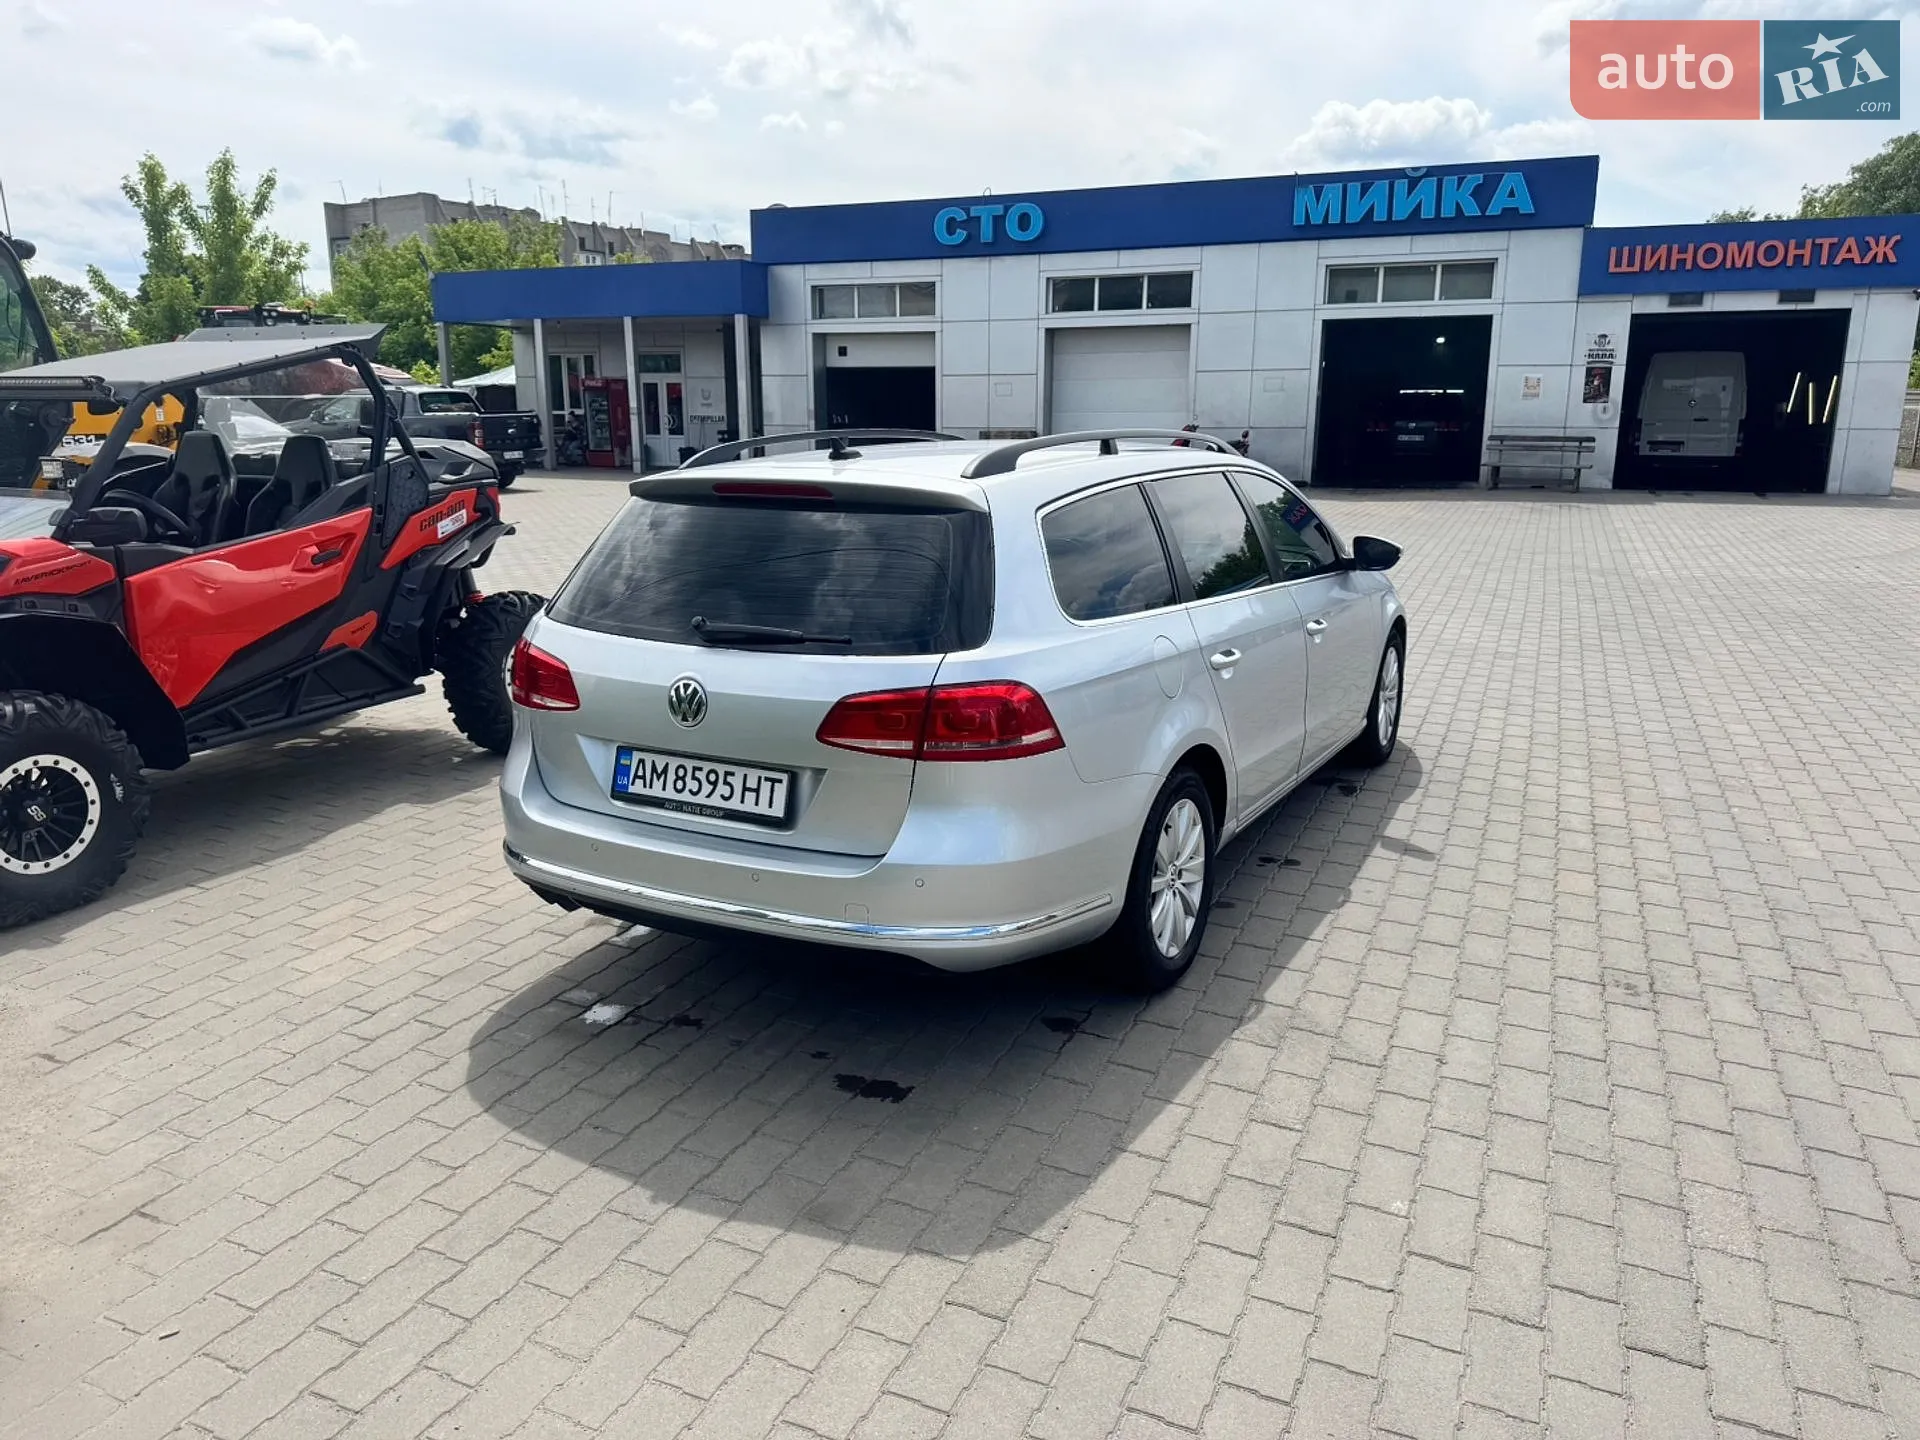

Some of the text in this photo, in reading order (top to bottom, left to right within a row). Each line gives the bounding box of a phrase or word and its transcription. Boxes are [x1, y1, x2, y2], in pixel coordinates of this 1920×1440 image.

[1293, 168, 1535, 225] МИЙКА
[934, 202, 1044, 245] СТО
[1608, 235, 1902, 273] ШИНОМОНТАЖ
[617, 775, 628, 785] UA
